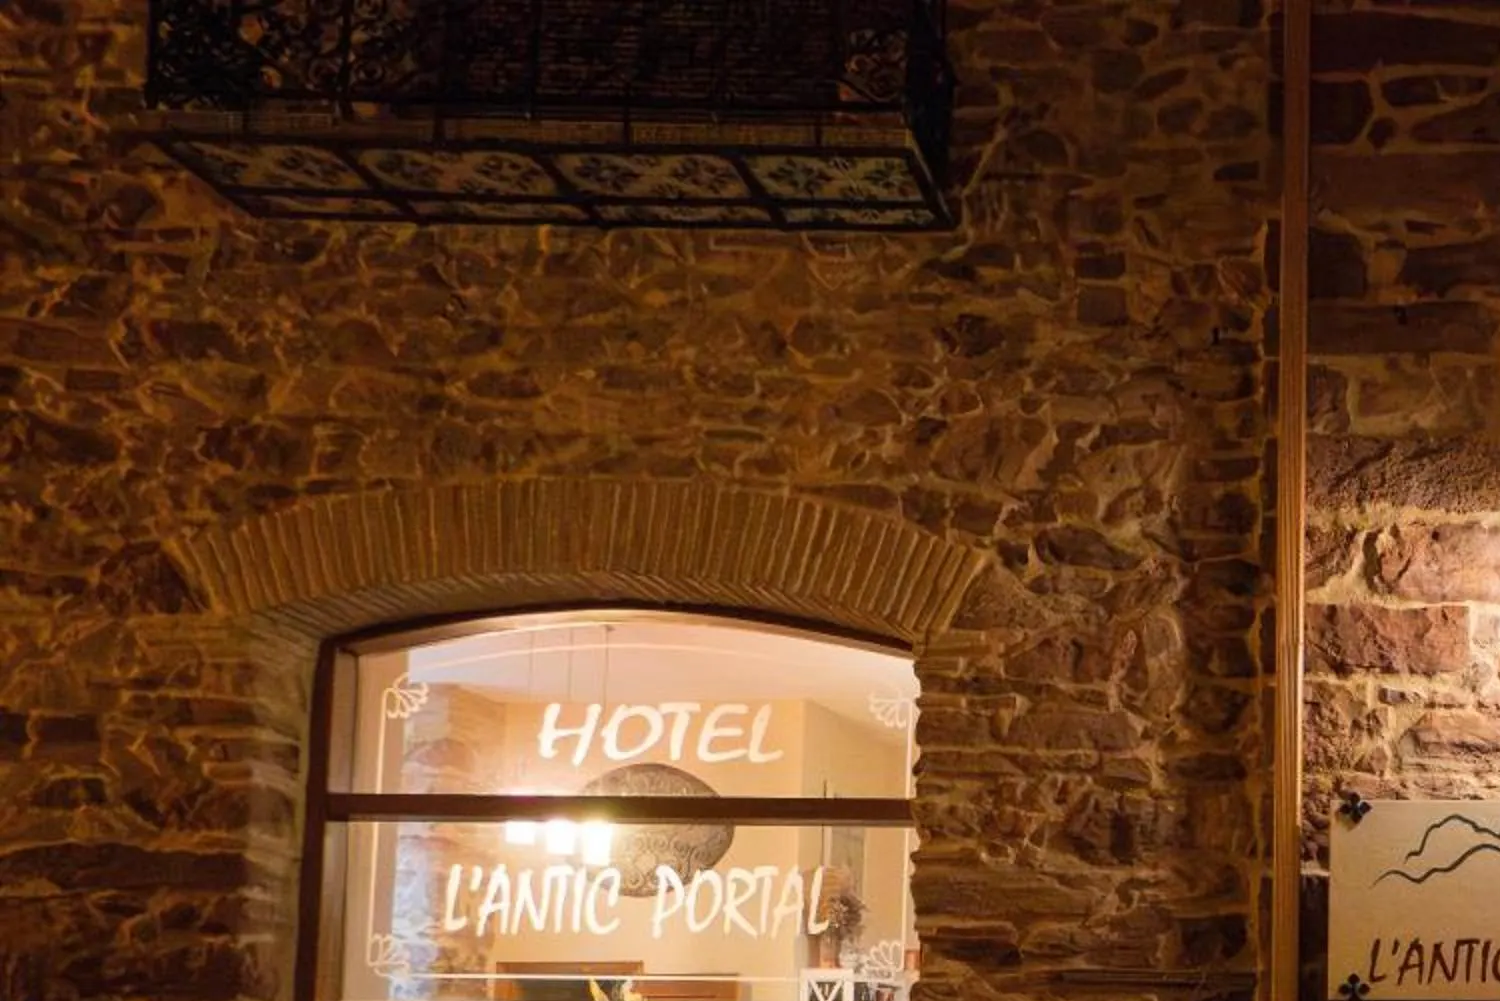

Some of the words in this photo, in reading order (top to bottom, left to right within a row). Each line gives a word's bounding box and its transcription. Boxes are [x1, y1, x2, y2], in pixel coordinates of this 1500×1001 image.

[537, 702, 784, 767] HOTEL
[442, 863, 621, 937] L'ANTIC
[650, 864, 830, 938] PORTAL
